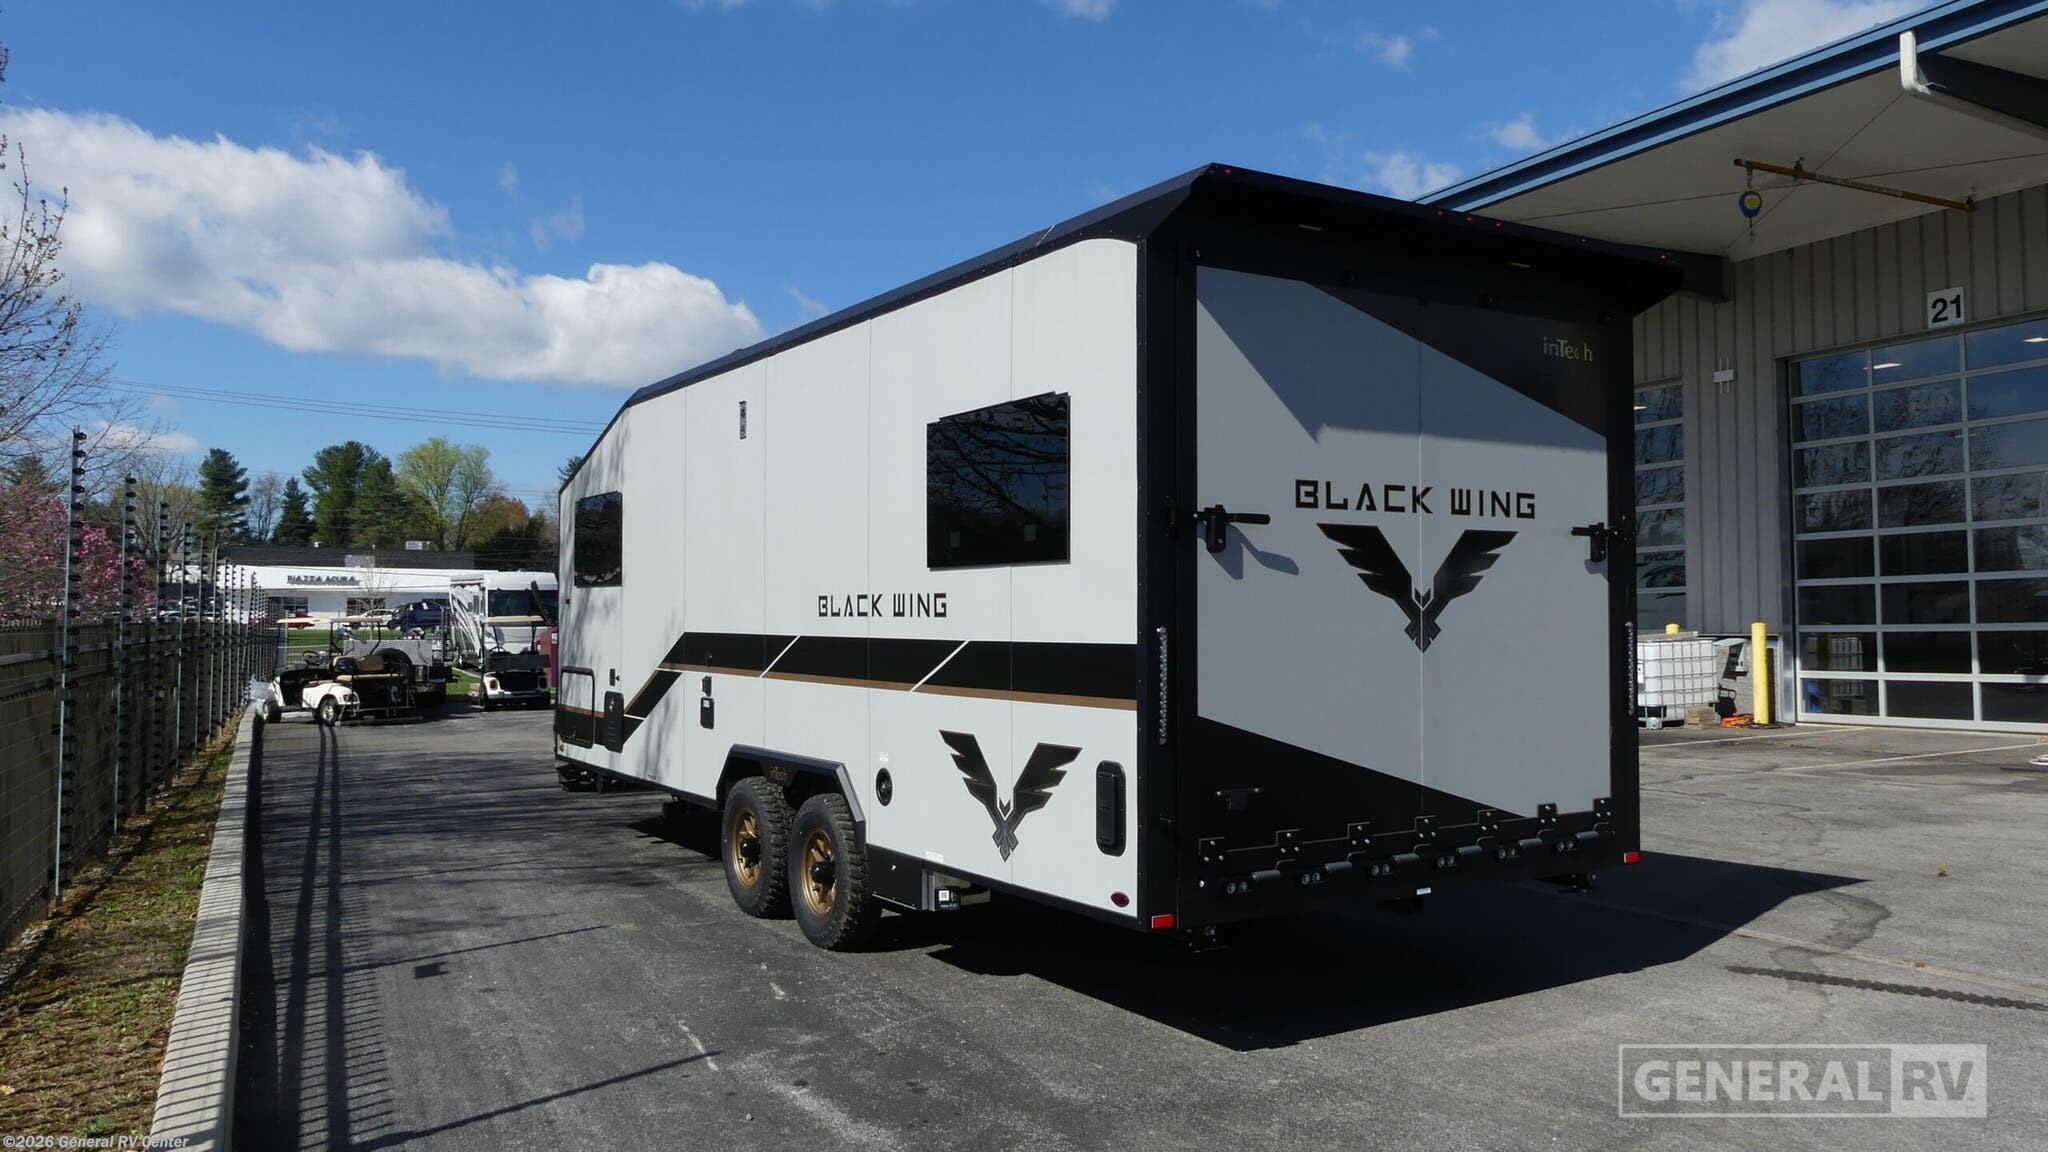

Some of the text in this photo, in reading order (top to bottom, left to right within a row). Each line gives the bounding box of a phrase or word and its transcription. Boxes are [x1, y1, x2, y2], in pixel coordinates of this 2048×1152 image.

[1931, 294, 1961, 323] 21
[1543, 337, 1592, 362] inTech
[1295, 479, 1536, 519] BLACK WING
[324, 575, 356, 584] ACURA
[818, 593, 947, 617] BLACK WING
